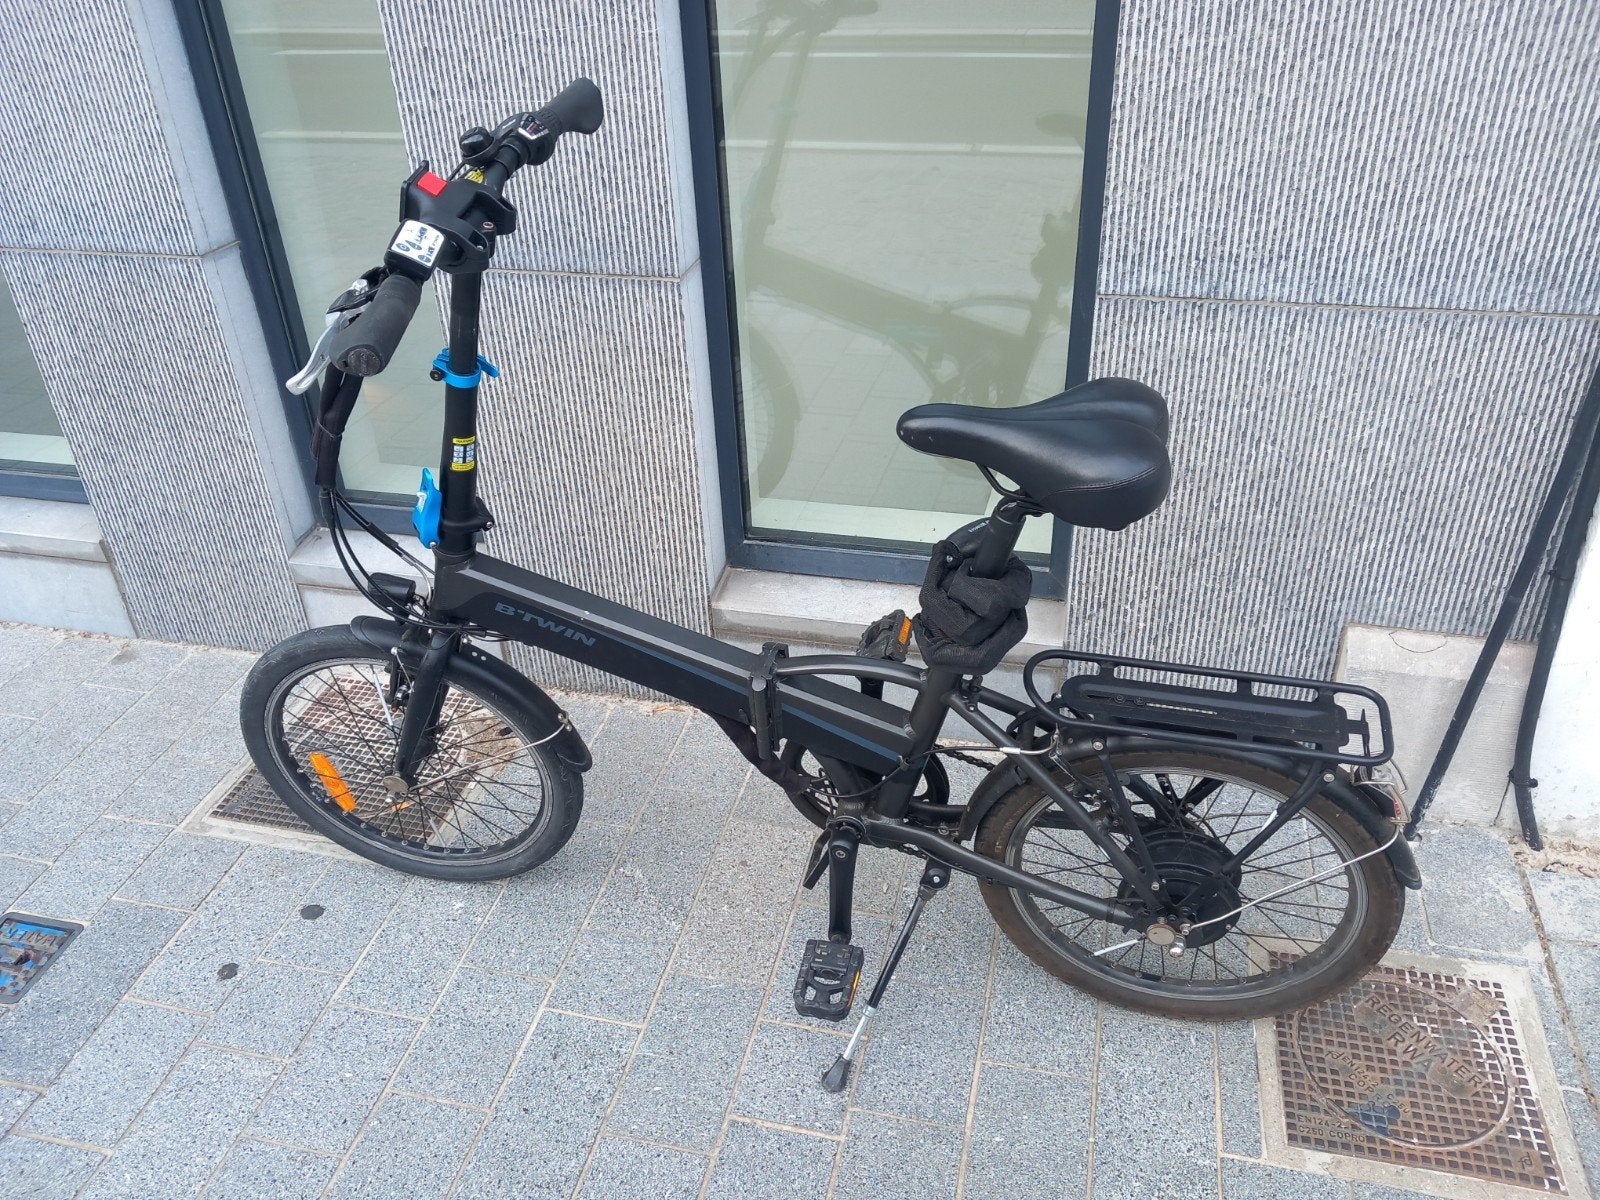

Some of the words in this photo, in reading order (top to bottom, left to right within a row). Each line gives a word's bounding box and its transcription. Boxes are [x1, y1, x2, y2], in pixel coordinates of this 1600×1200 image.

[1367, 995, 1482, 1087] REGENWATER
[1387, 1031, 1434, 1072] RWA
[1329, 1130, 1366, 1143] COPRO
